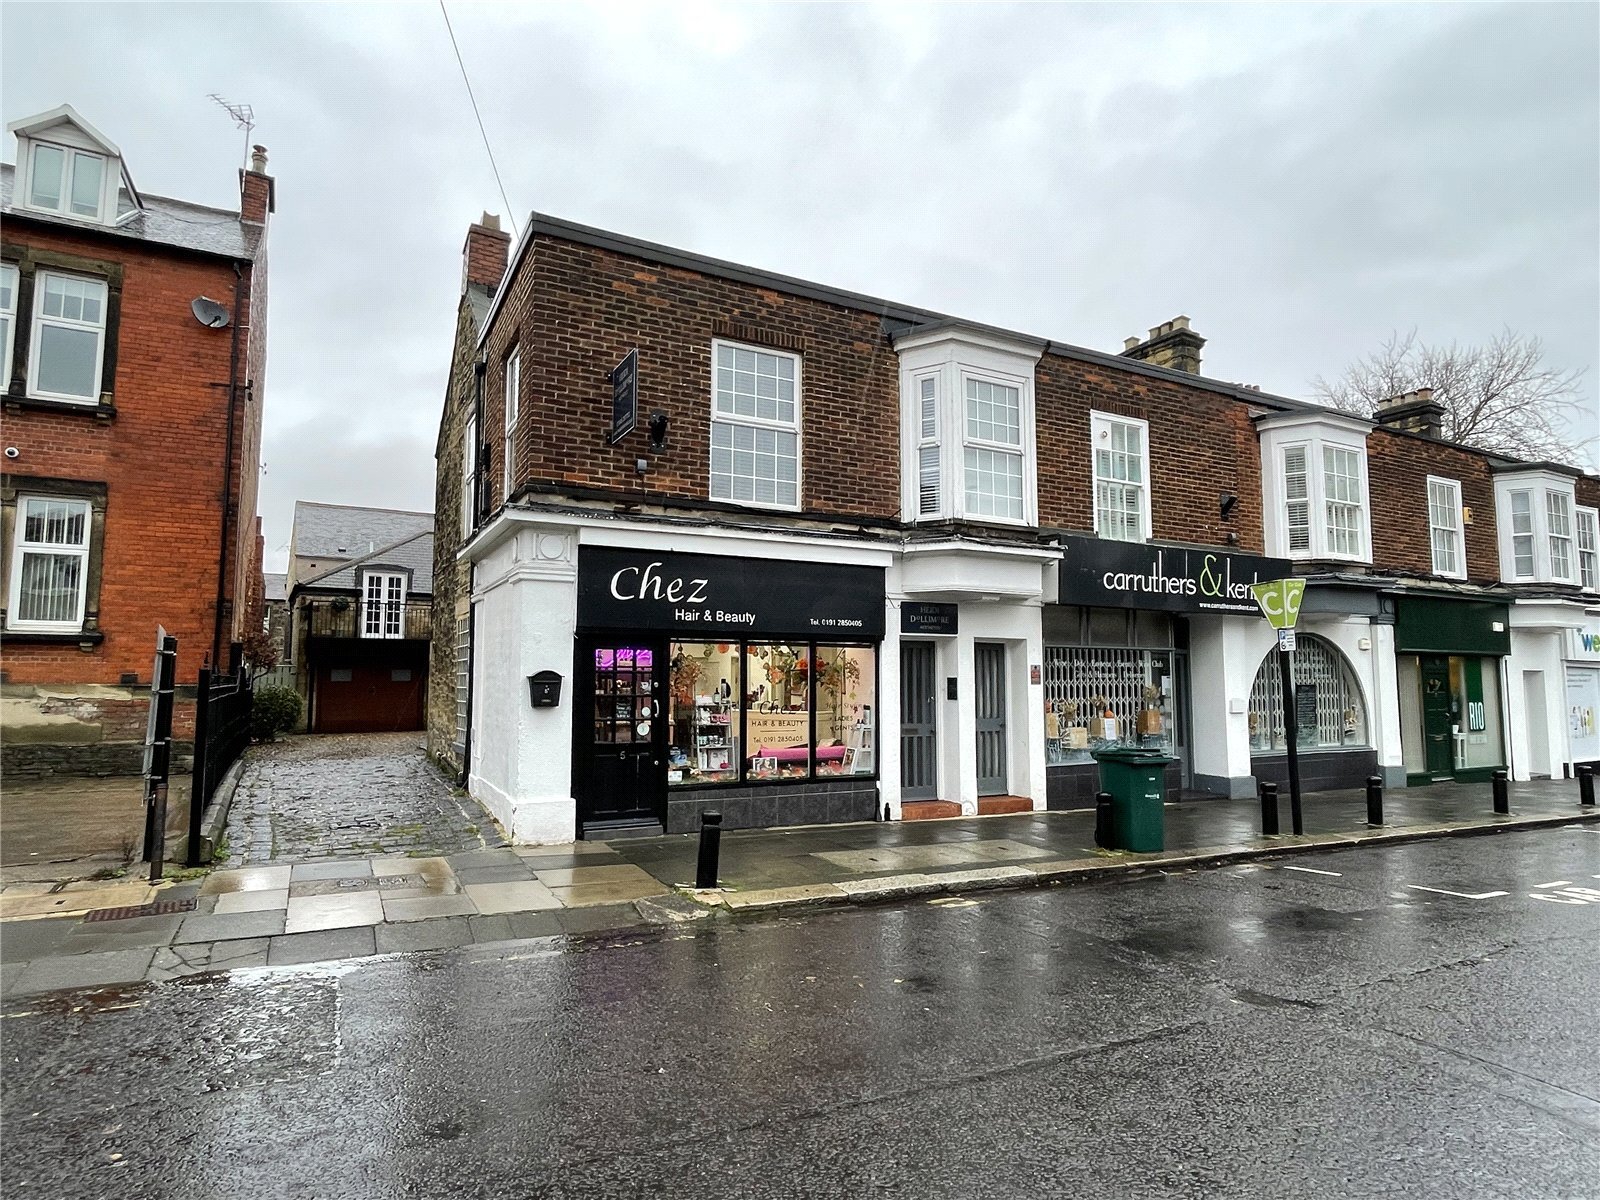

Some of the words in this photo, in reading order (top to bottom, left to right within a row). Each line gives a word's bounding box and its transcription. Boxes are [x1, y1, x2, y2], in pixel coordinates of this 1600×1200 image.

[610, 562, 708, 603] Chez
[1103, 550, 1196, 595] carruthers
[1200, 554, 1224, 597] &
[1262, 592, 1283, 615] C
[1287, 590, 1300, 613] C
[675, 609, 700, 621] Hair
[704, 610, 712, 621] &
[716, 610, 756, 625] Beauty
[810, 618, 820, 626] Tel.
[760, 699, 802, 715] Chez
[1468, 702, 1485, 730] RIO
[778, 735, 803, 743] 2850405
[620, 751, 626, 760] 5
